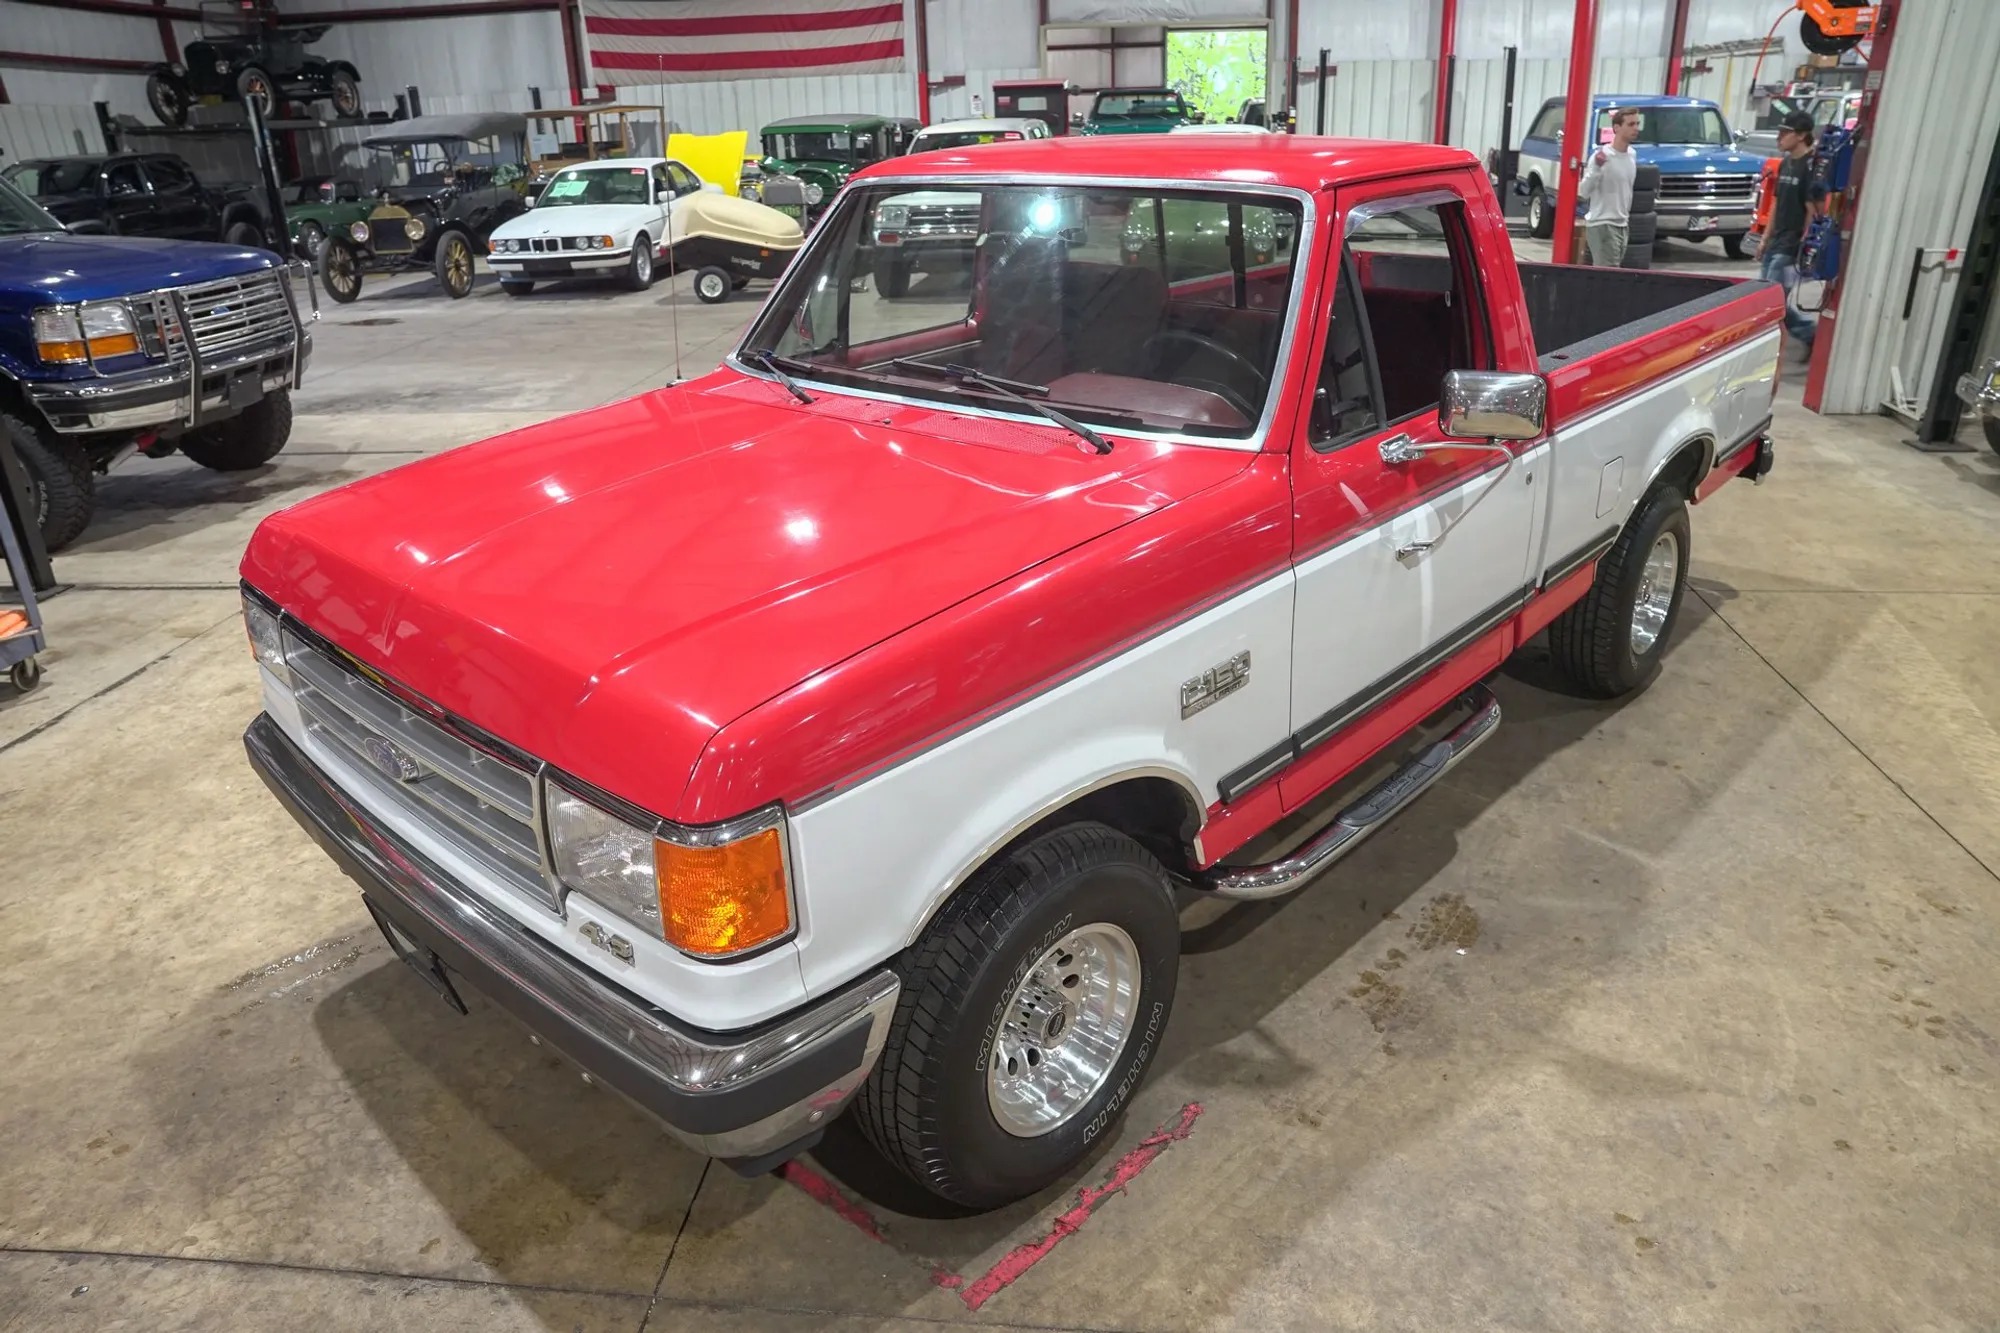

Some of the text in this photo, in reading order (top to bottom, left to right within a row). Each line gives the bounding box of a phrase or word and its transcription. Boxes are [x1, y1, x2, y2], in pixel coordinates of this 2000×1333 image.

[1181, 650, 1251, 709] F-150
[975, 913, 1072, 1071] MICHELIN
[1083, 1002, 1164, 1144] MICHELIN
